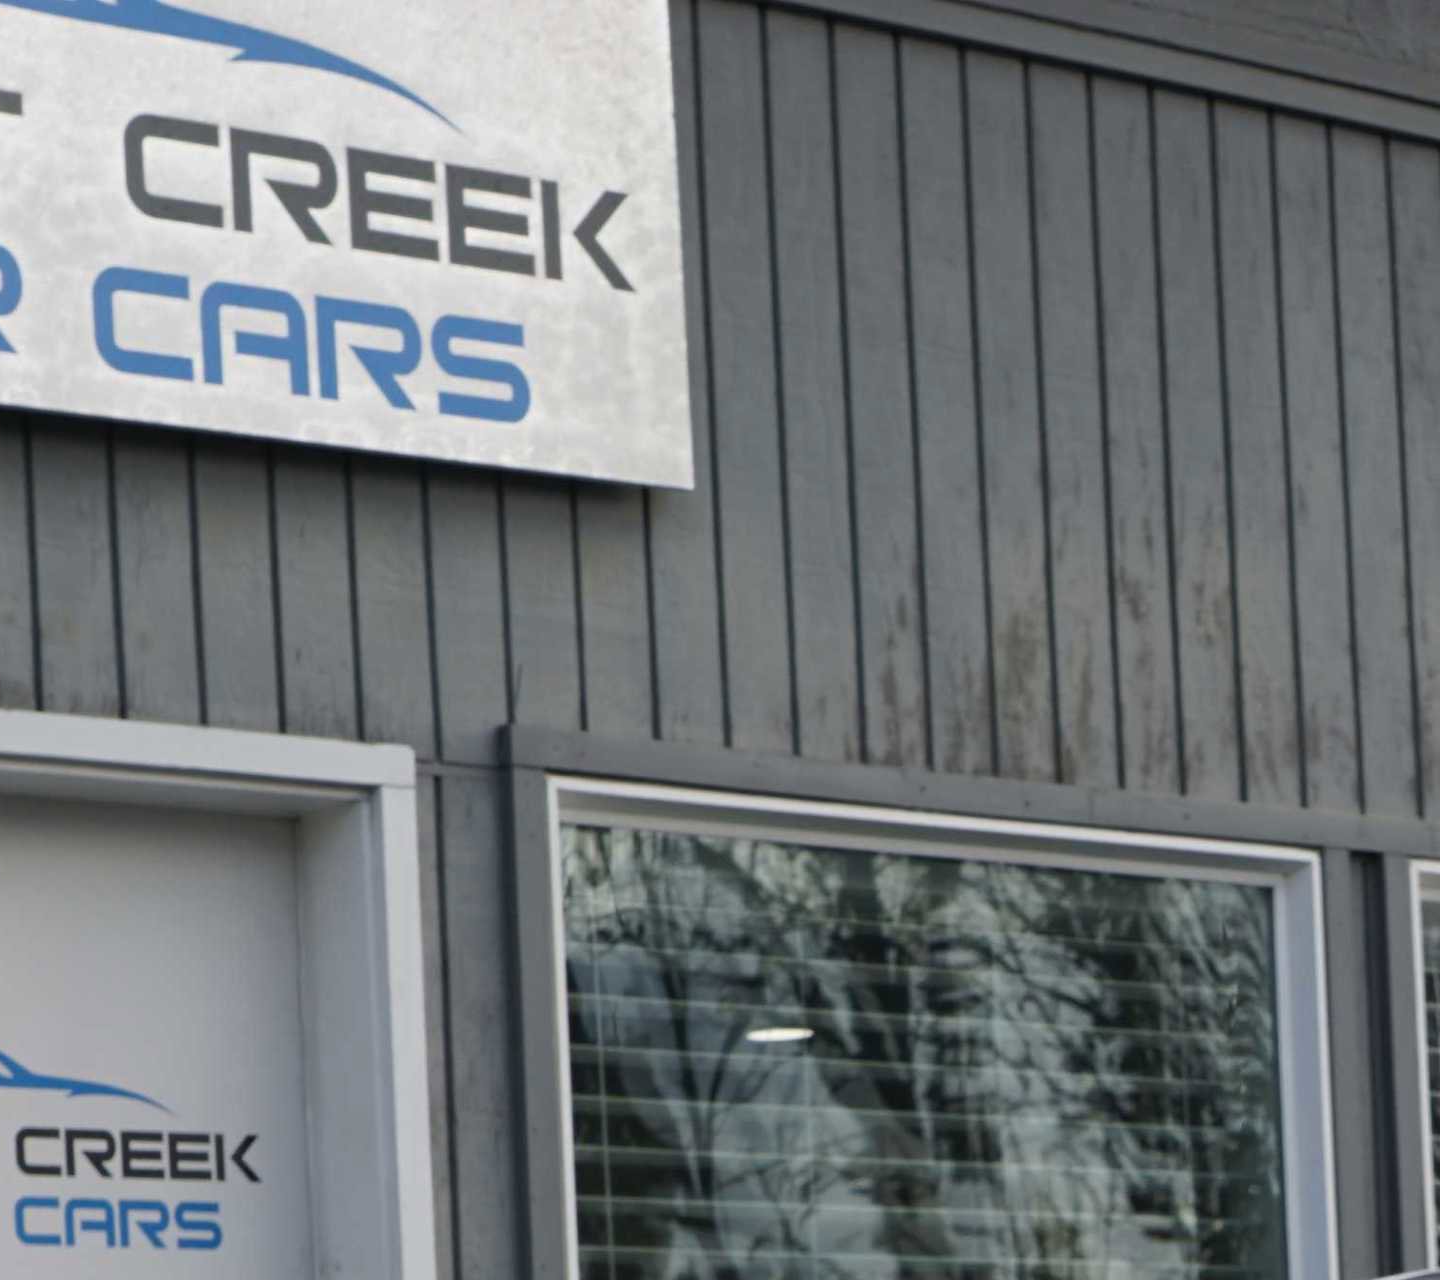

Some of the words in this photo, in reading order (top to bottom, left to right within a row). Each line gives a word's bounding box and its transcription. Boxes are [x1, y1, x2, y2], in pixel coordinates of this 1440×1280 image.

[123, 111, 637, 292] CREEK
[93, 266, 532, 423] CARS
[15, 1126, 263, 1185] CREEK
[14, 1194, 224, 1250] CARS
